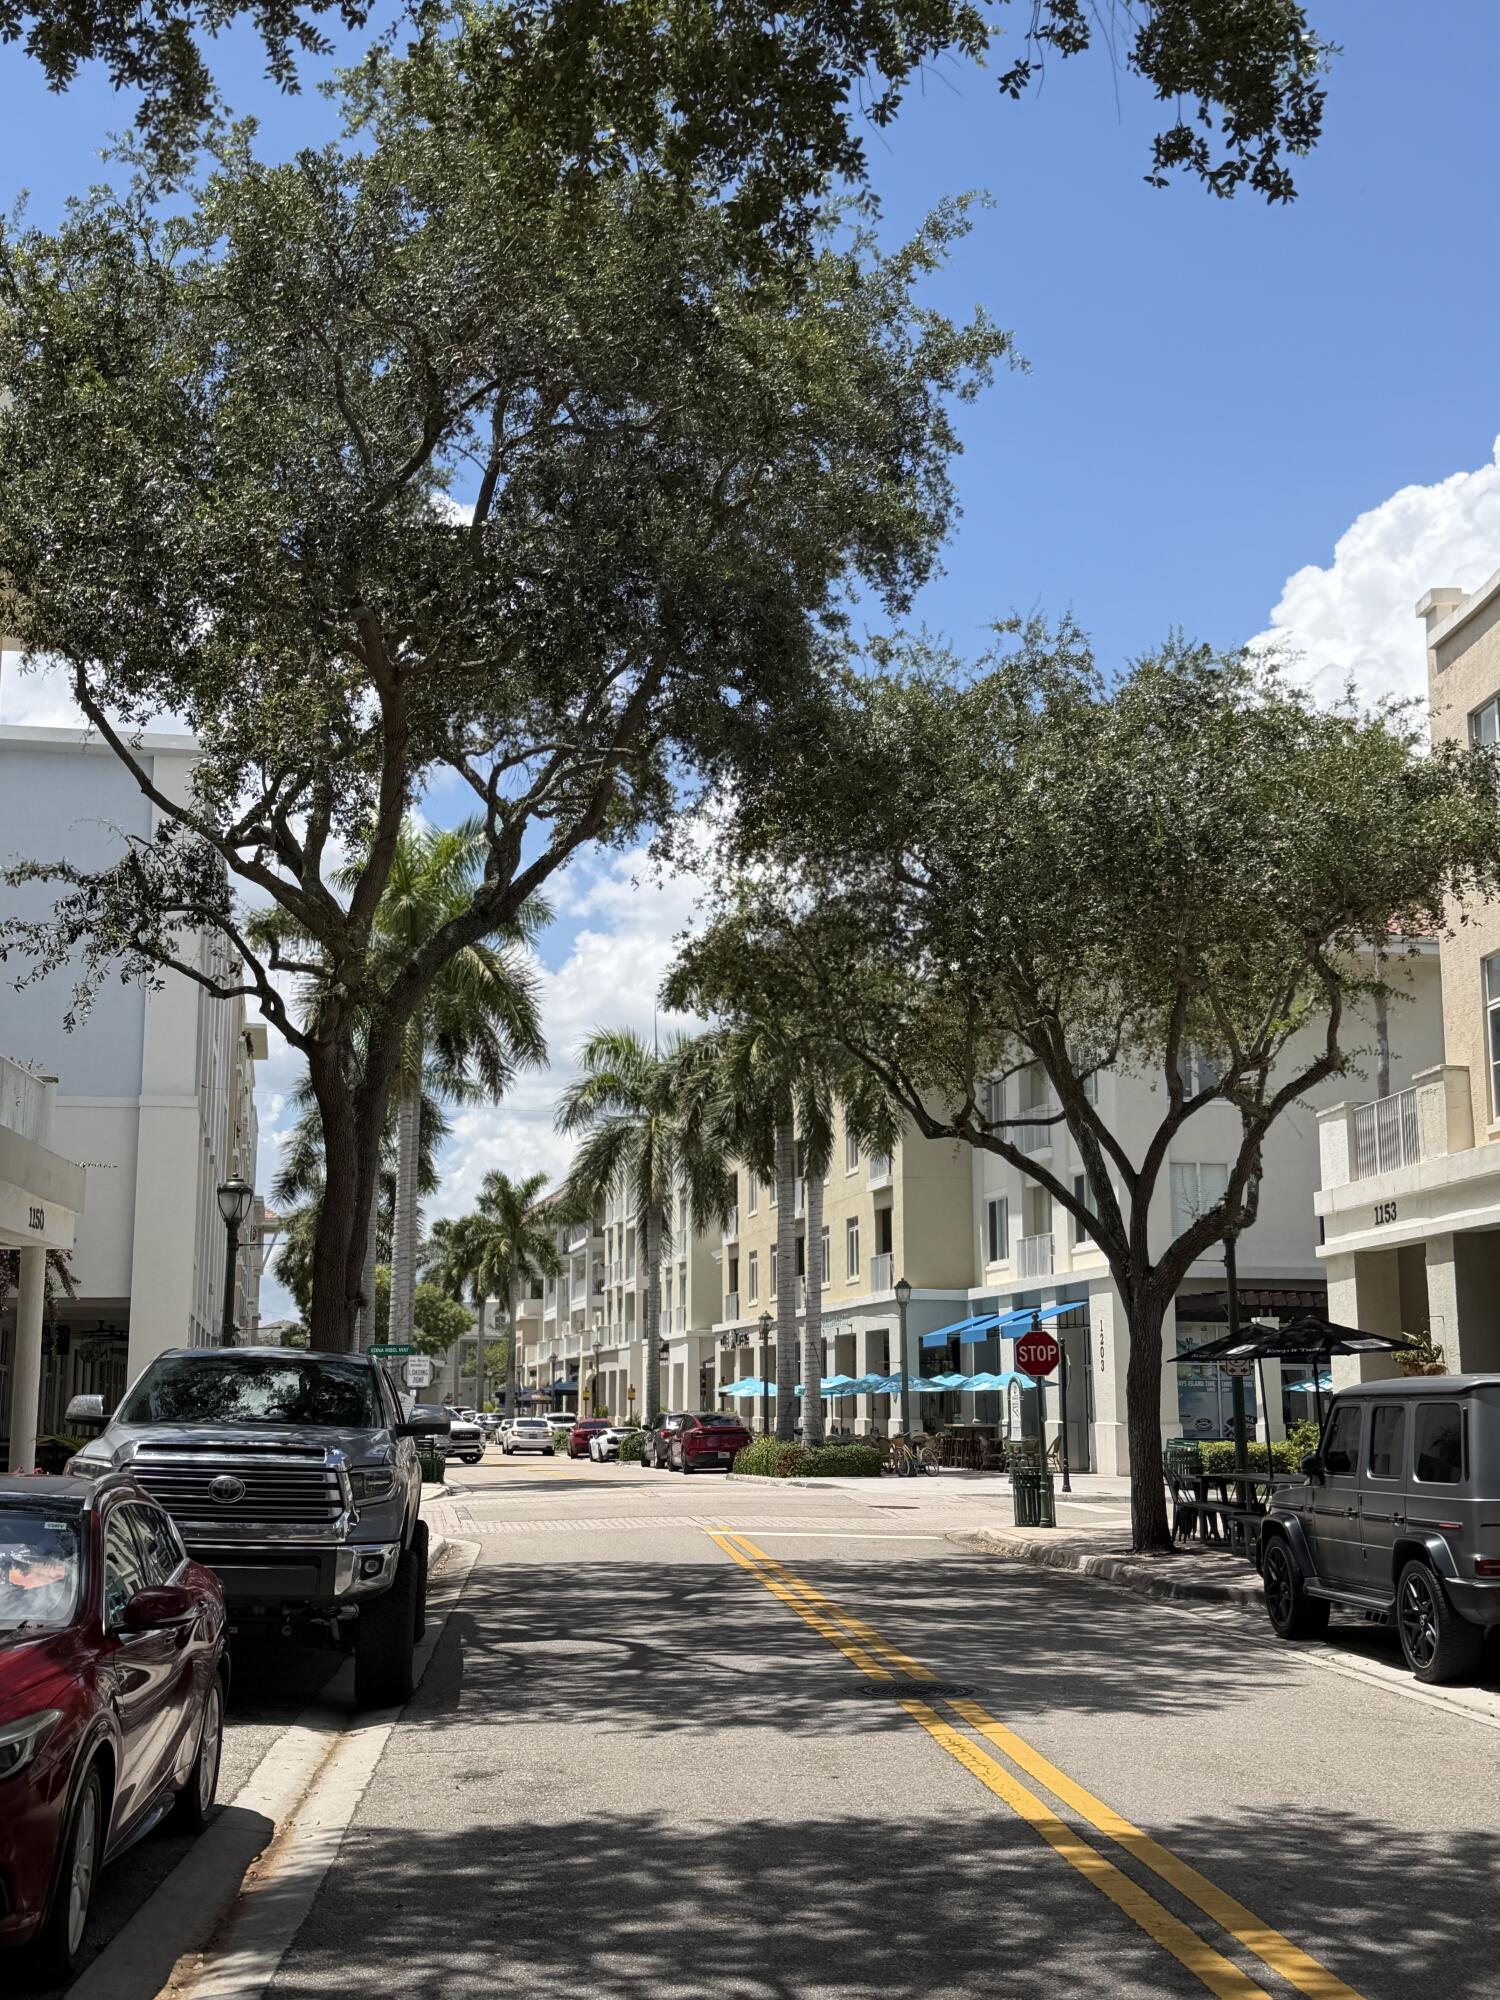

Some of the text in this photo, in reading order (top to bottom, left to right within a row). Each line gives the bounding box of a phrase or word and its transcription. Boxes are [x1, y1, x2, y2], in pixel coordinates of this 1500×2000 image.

[28, 1206, 45, 1231] 1150
[1374, 1201, 1397, 1226] 1153
[1018, 1345, 1057, 1362] STOP
